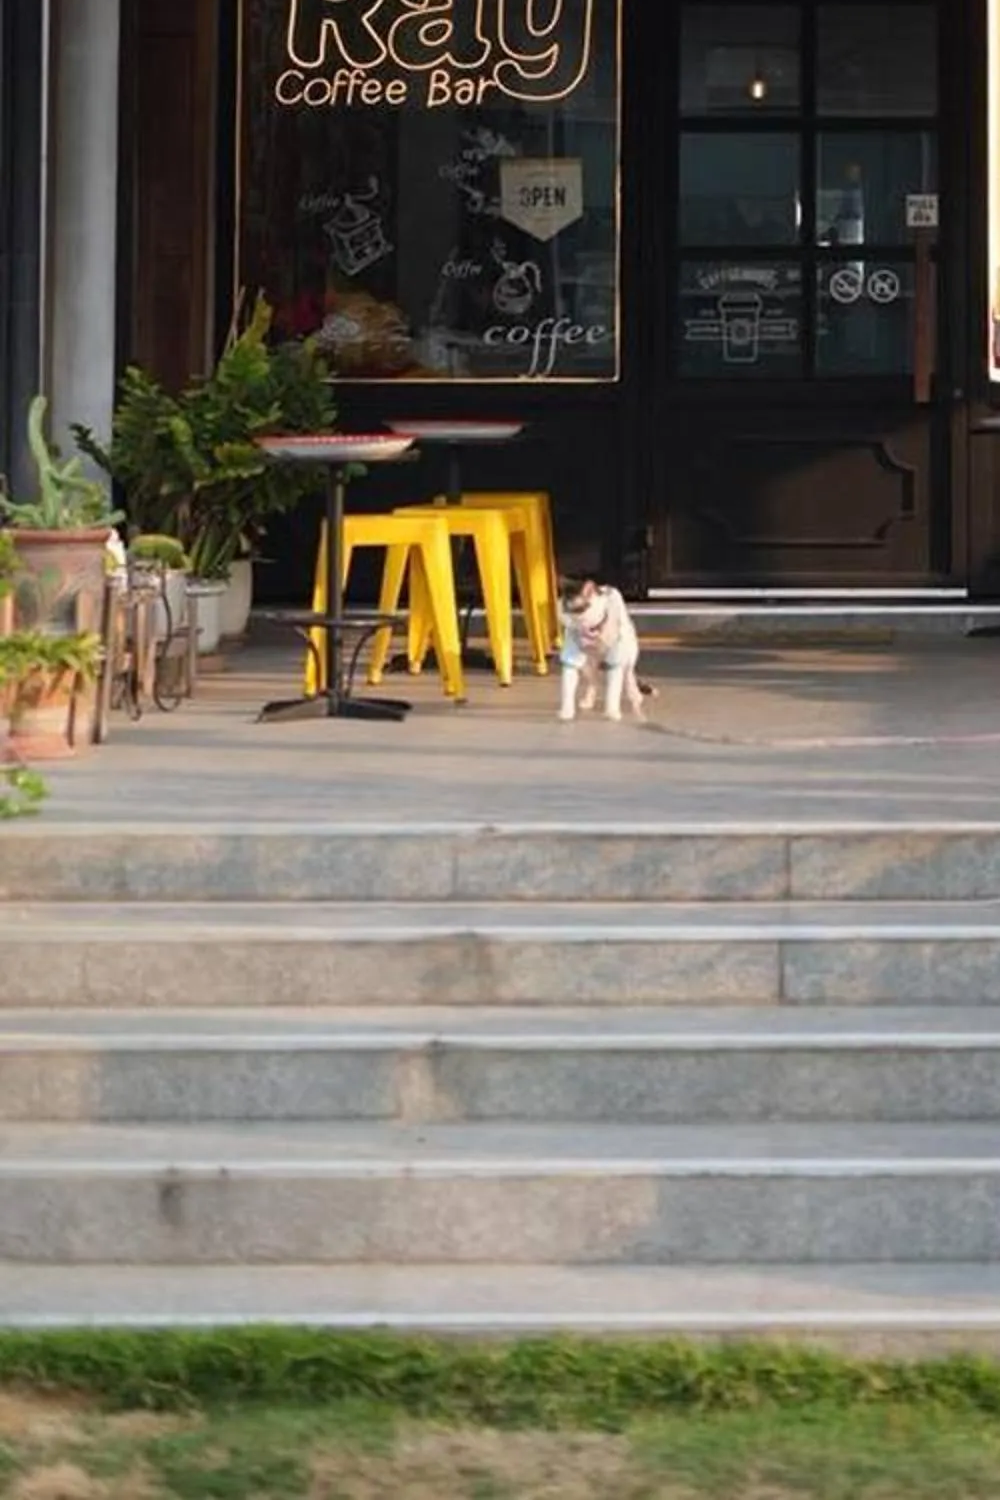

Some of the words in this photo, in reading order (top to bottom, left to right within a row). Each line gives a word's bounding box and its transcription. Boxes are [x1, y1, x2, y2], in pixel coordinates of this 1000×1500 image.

[275, 68, 407, 106] Coffee
[426, 69, 497, 108] Bar
[518, 185, 567, 209] OPEN
[482, 316, 606, 379] coffee
